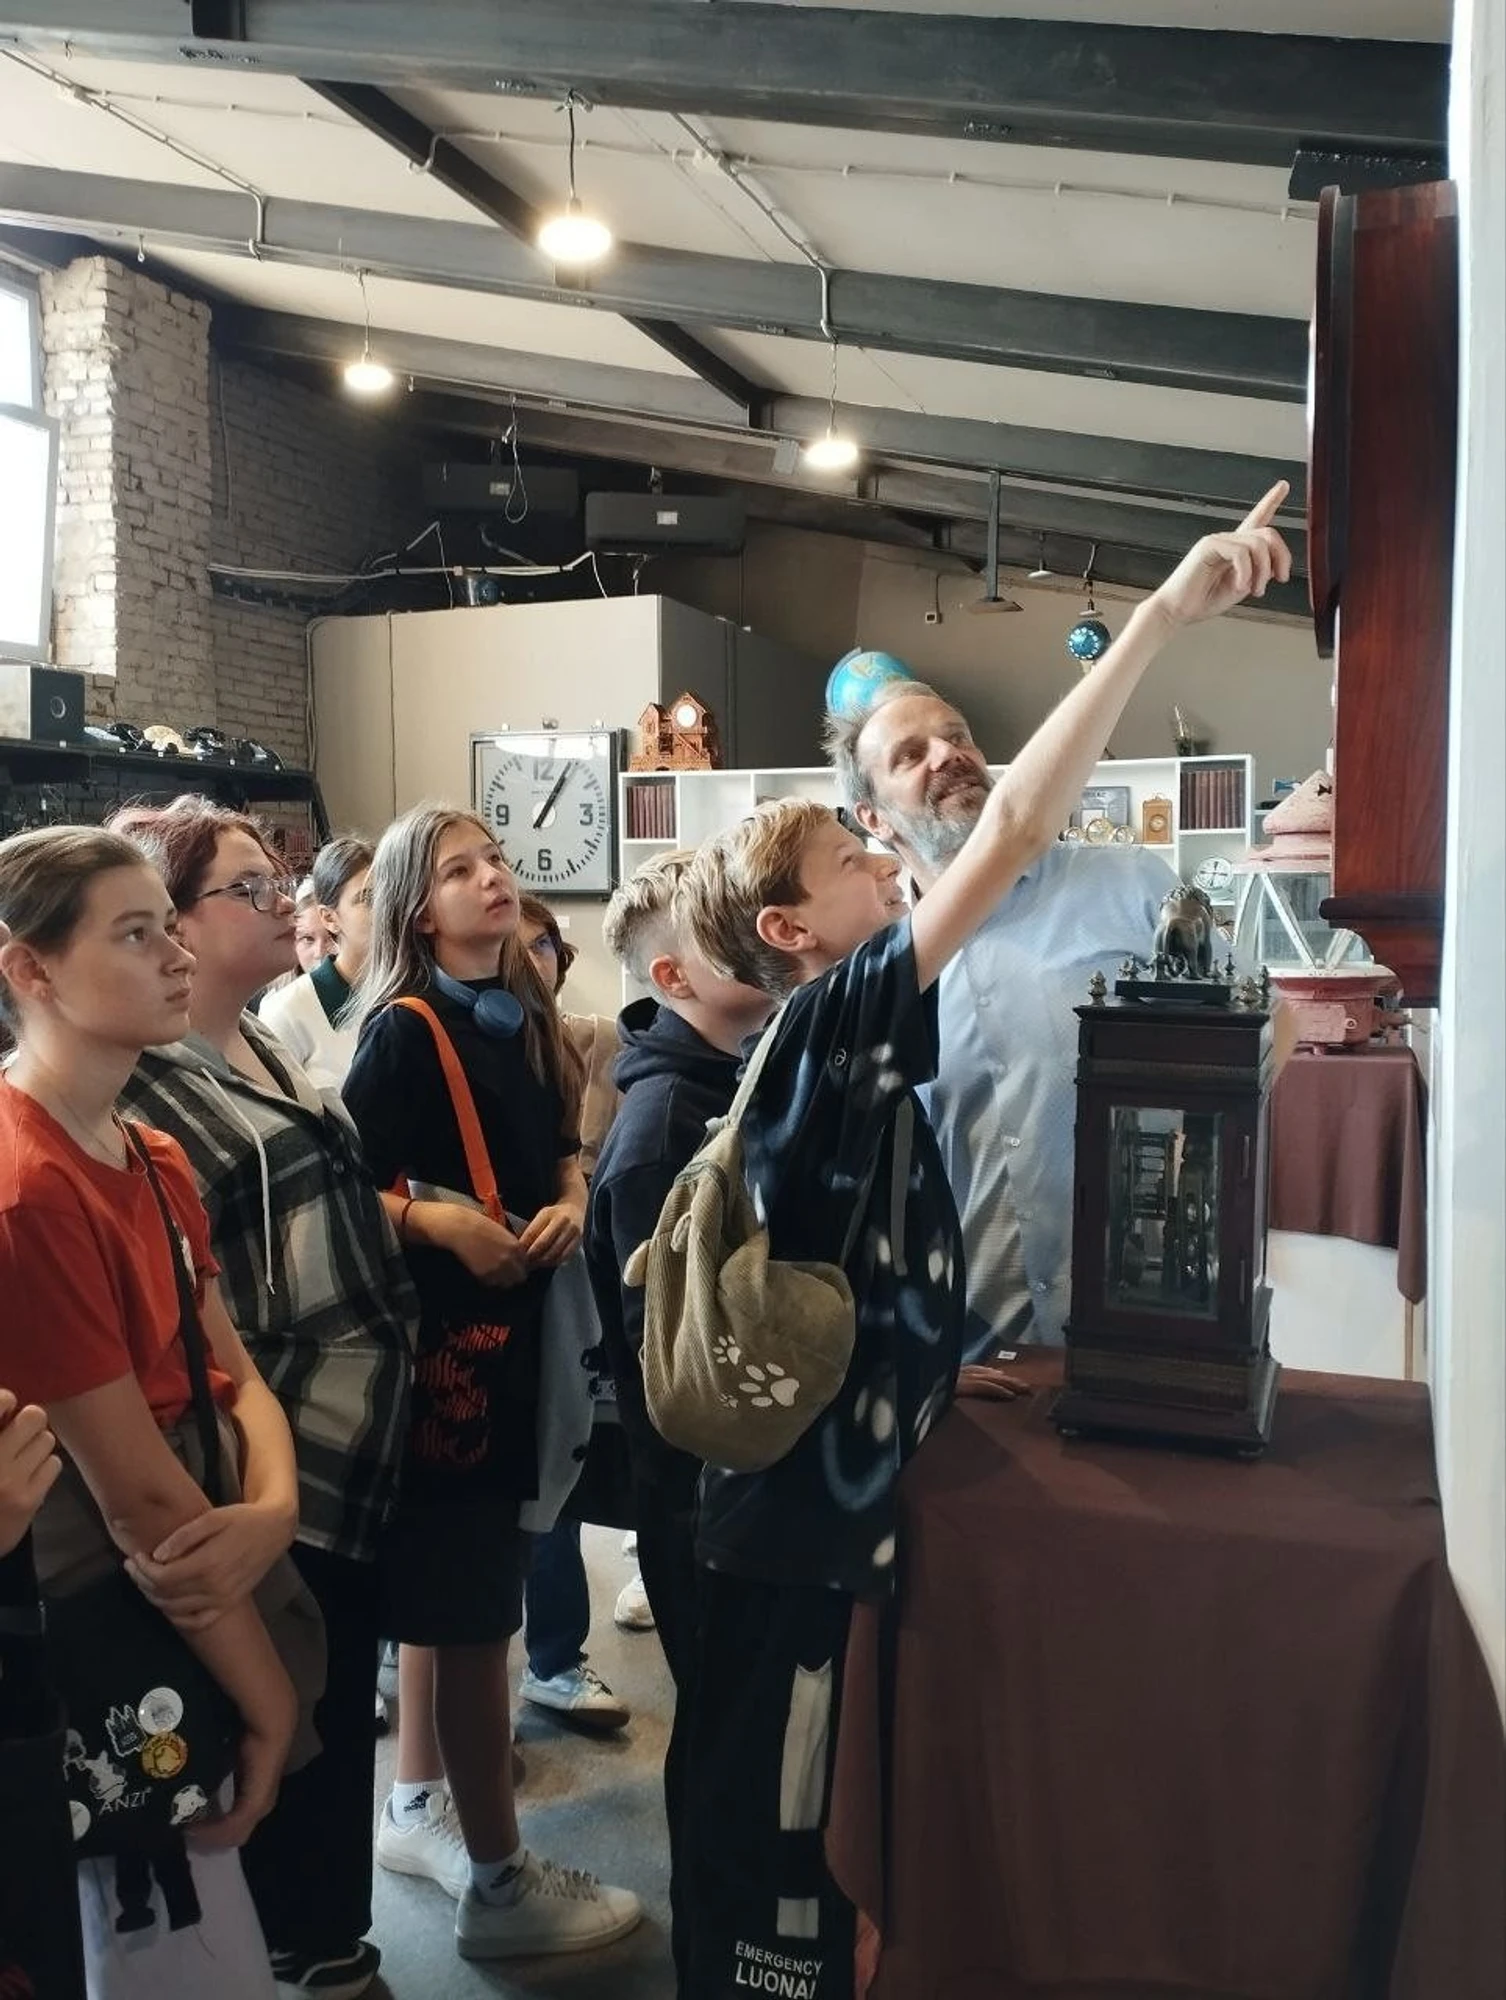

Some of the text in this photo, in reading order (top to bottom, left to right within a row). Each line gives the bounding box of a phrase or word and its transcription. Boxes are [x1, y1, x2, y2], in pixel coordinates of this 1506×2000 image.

[533, 758, 554, 781] 12
[496, 804, 509, 826] 9
[580, 803, 593, 826] 3
[538, 849, 551, 871] 6
[735, 1941, 822, 1976] EMERGENCY
